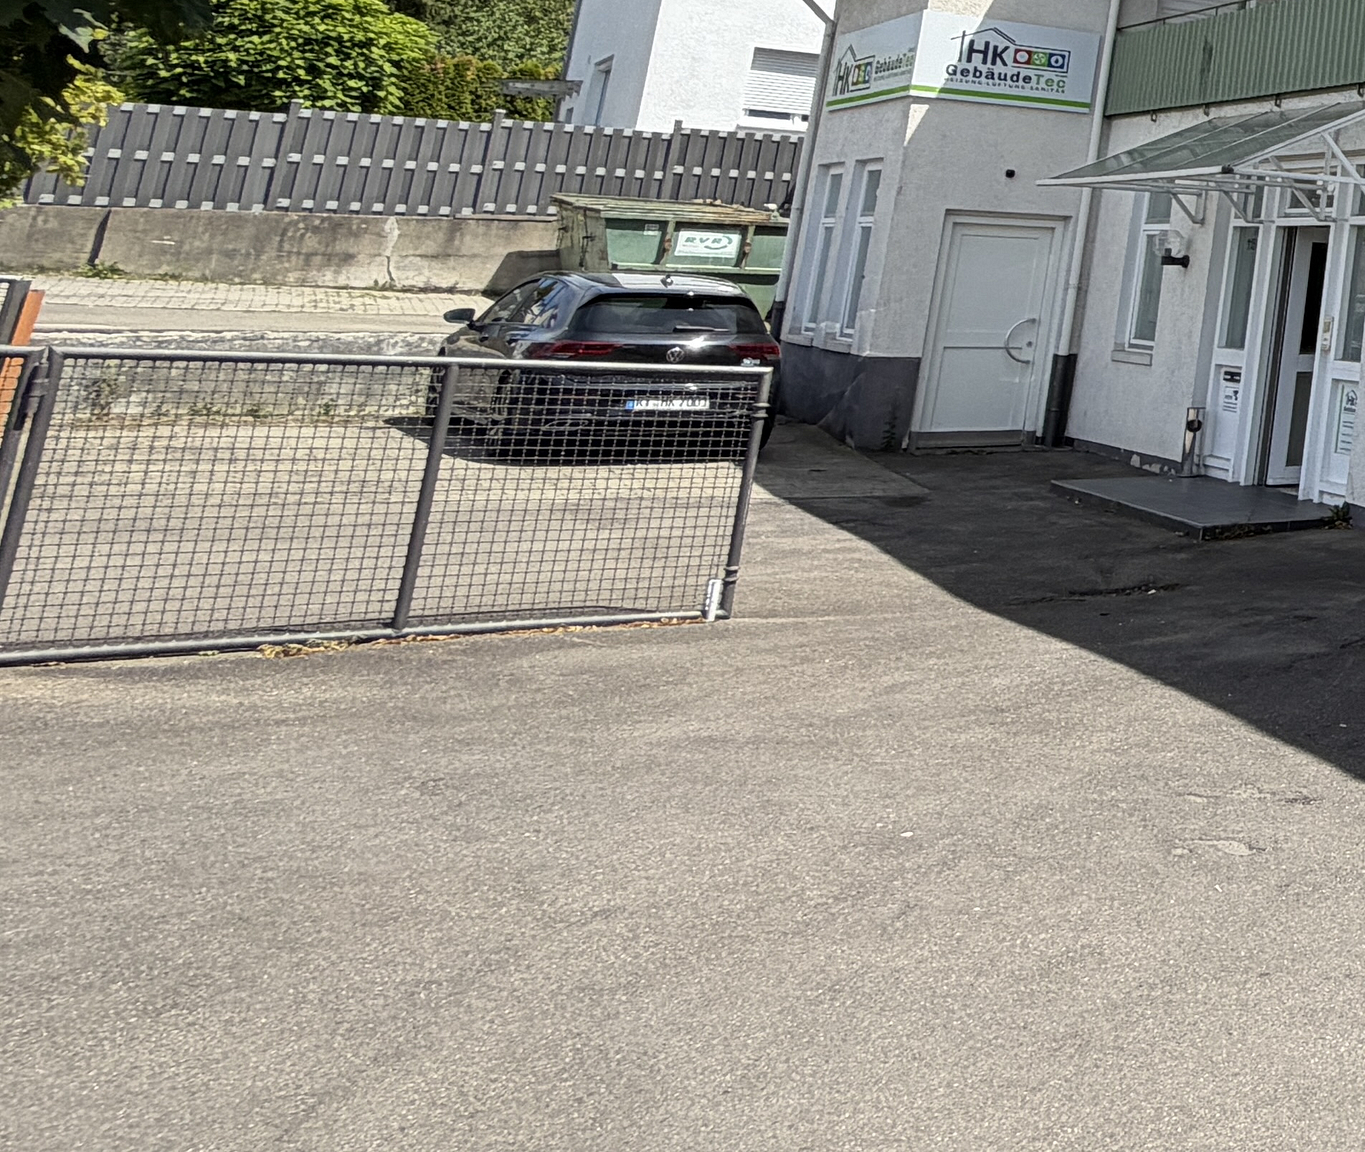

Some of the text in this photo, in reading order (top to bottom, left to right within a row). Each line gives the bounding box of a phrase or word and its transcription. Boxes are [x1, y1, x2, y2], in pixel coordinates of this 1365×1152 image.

[966, 39, 1010, 67] HK
[946, 64, 1066, 89] GebäudeTec
[684, 236, 723, 245] RVR
